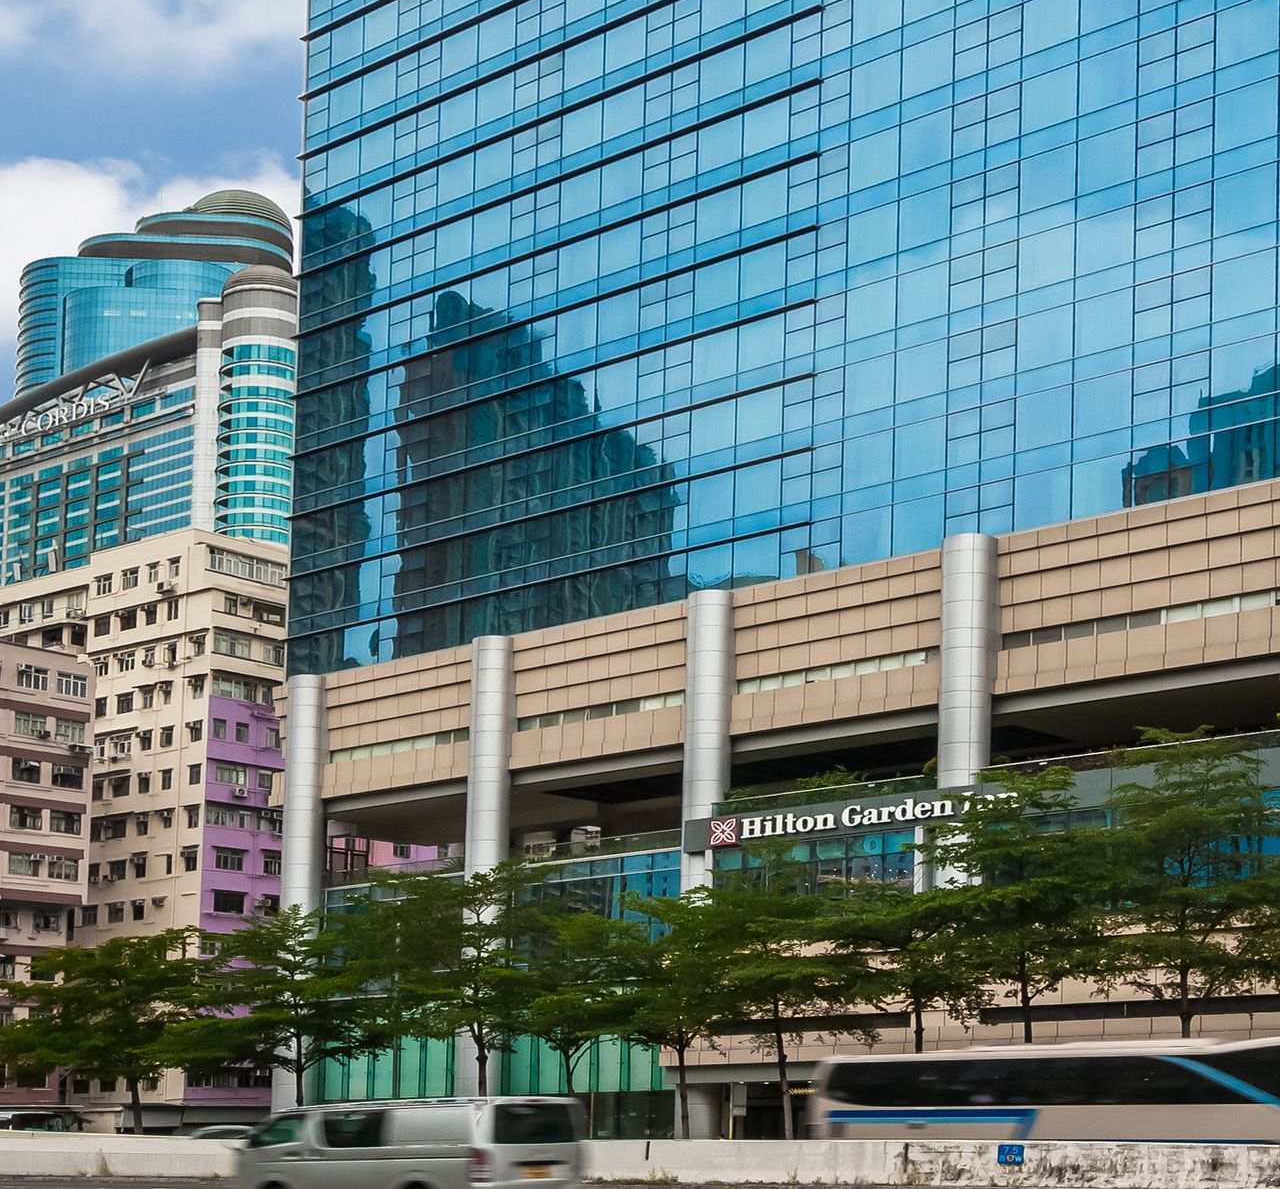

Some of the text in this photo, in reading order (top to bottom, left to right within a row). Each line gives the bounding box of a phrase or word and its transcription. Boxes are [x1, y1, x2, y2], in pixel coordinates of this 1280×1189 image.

[22, 393, 110, 436] CORDIS
[740, 813, 837, 839] Hilton
[841, 798, 955, 828] Garden
